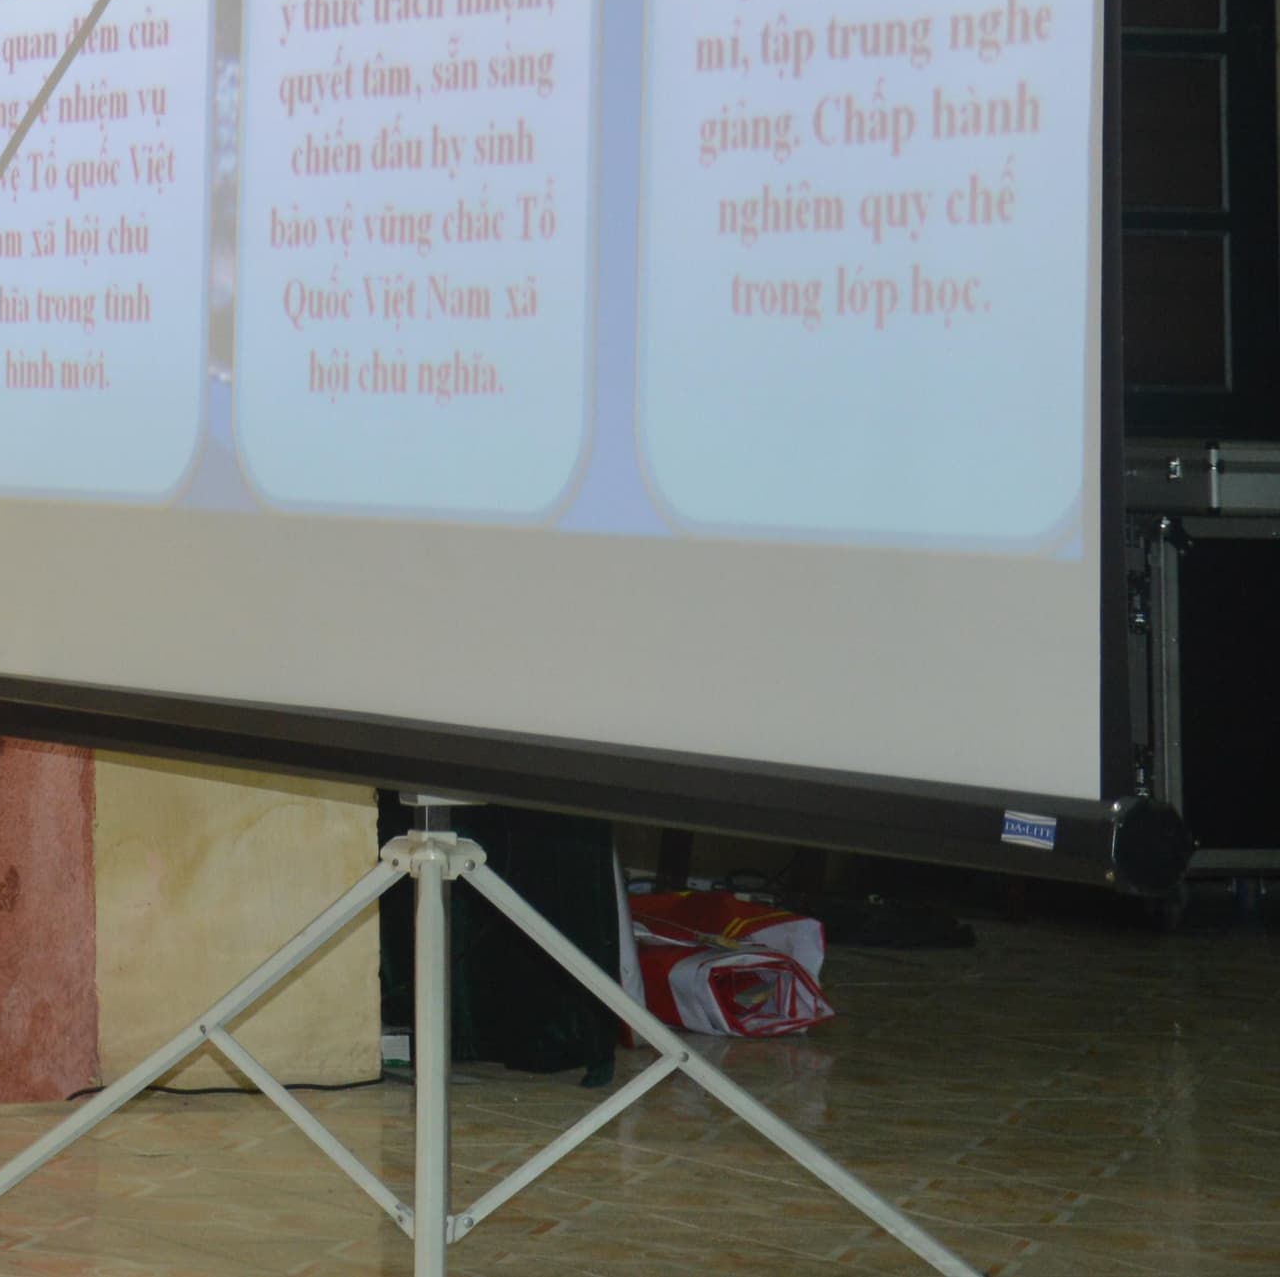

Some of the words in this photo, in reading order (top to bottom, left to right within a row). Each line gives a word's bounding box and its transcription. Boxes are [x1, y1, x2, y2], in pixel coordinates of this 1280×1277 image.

[2, 31, 57, 74] quan
[129, 5, 170, 50] của
[760, 12, 815, 80] tập
[826, 12, 935, 69] trung
[58, 78, 129, 132] nhiệm
[137, 86, 167, 127] vụ
[279, 44, 353, 117] quyết
[431, 34, 479, 93] sẵn
[487, 40, 556, 99] sàng
[290, 116, 362, 176] chiến
[370, 113, 423, 172] đấu
[431, 123, 465, 181] hy
[472, 116, 535, 166] sinh
[812, 74, 916, 158] Chấp
[931, 78, 1041, 141] hành
[27, 135, 58, 192] Tổ
[65, 133, 121, 201] quốc
[129, 140, 175, 195] Việt
[717, 178, 845, 248] nghiêm
[858, 190, 935, 245] quy
[944, 152, 1017, 227] chế
[32, 219, 56, 257] xã
[65, 214, 100, 267] hội
[107, 211, 150, 255] chủ
[270, 202, 318, 249] bảo
[324, 199, 354, 260] vệ
[362, 202, 434, 259] vững
[441, 180, 506, 244] chắc
[516, 176, 558, 243] Tổ
[36, 289, 97, 332] trong
[104, 283, 152, 323] tình
[282, 262, 353, 331] Quốc
[362, 271, 417, 331] Việt
[424, 273, 491, 322] Nam
[504, 274, 539, 320] xã
[729, 272, 824, 332] trong
[910, 262, 993, 330] học.
[5, 349, 55, 389] hình
[307, 346, 351, 404] hội
[357, 346, 408, 395] chủ
